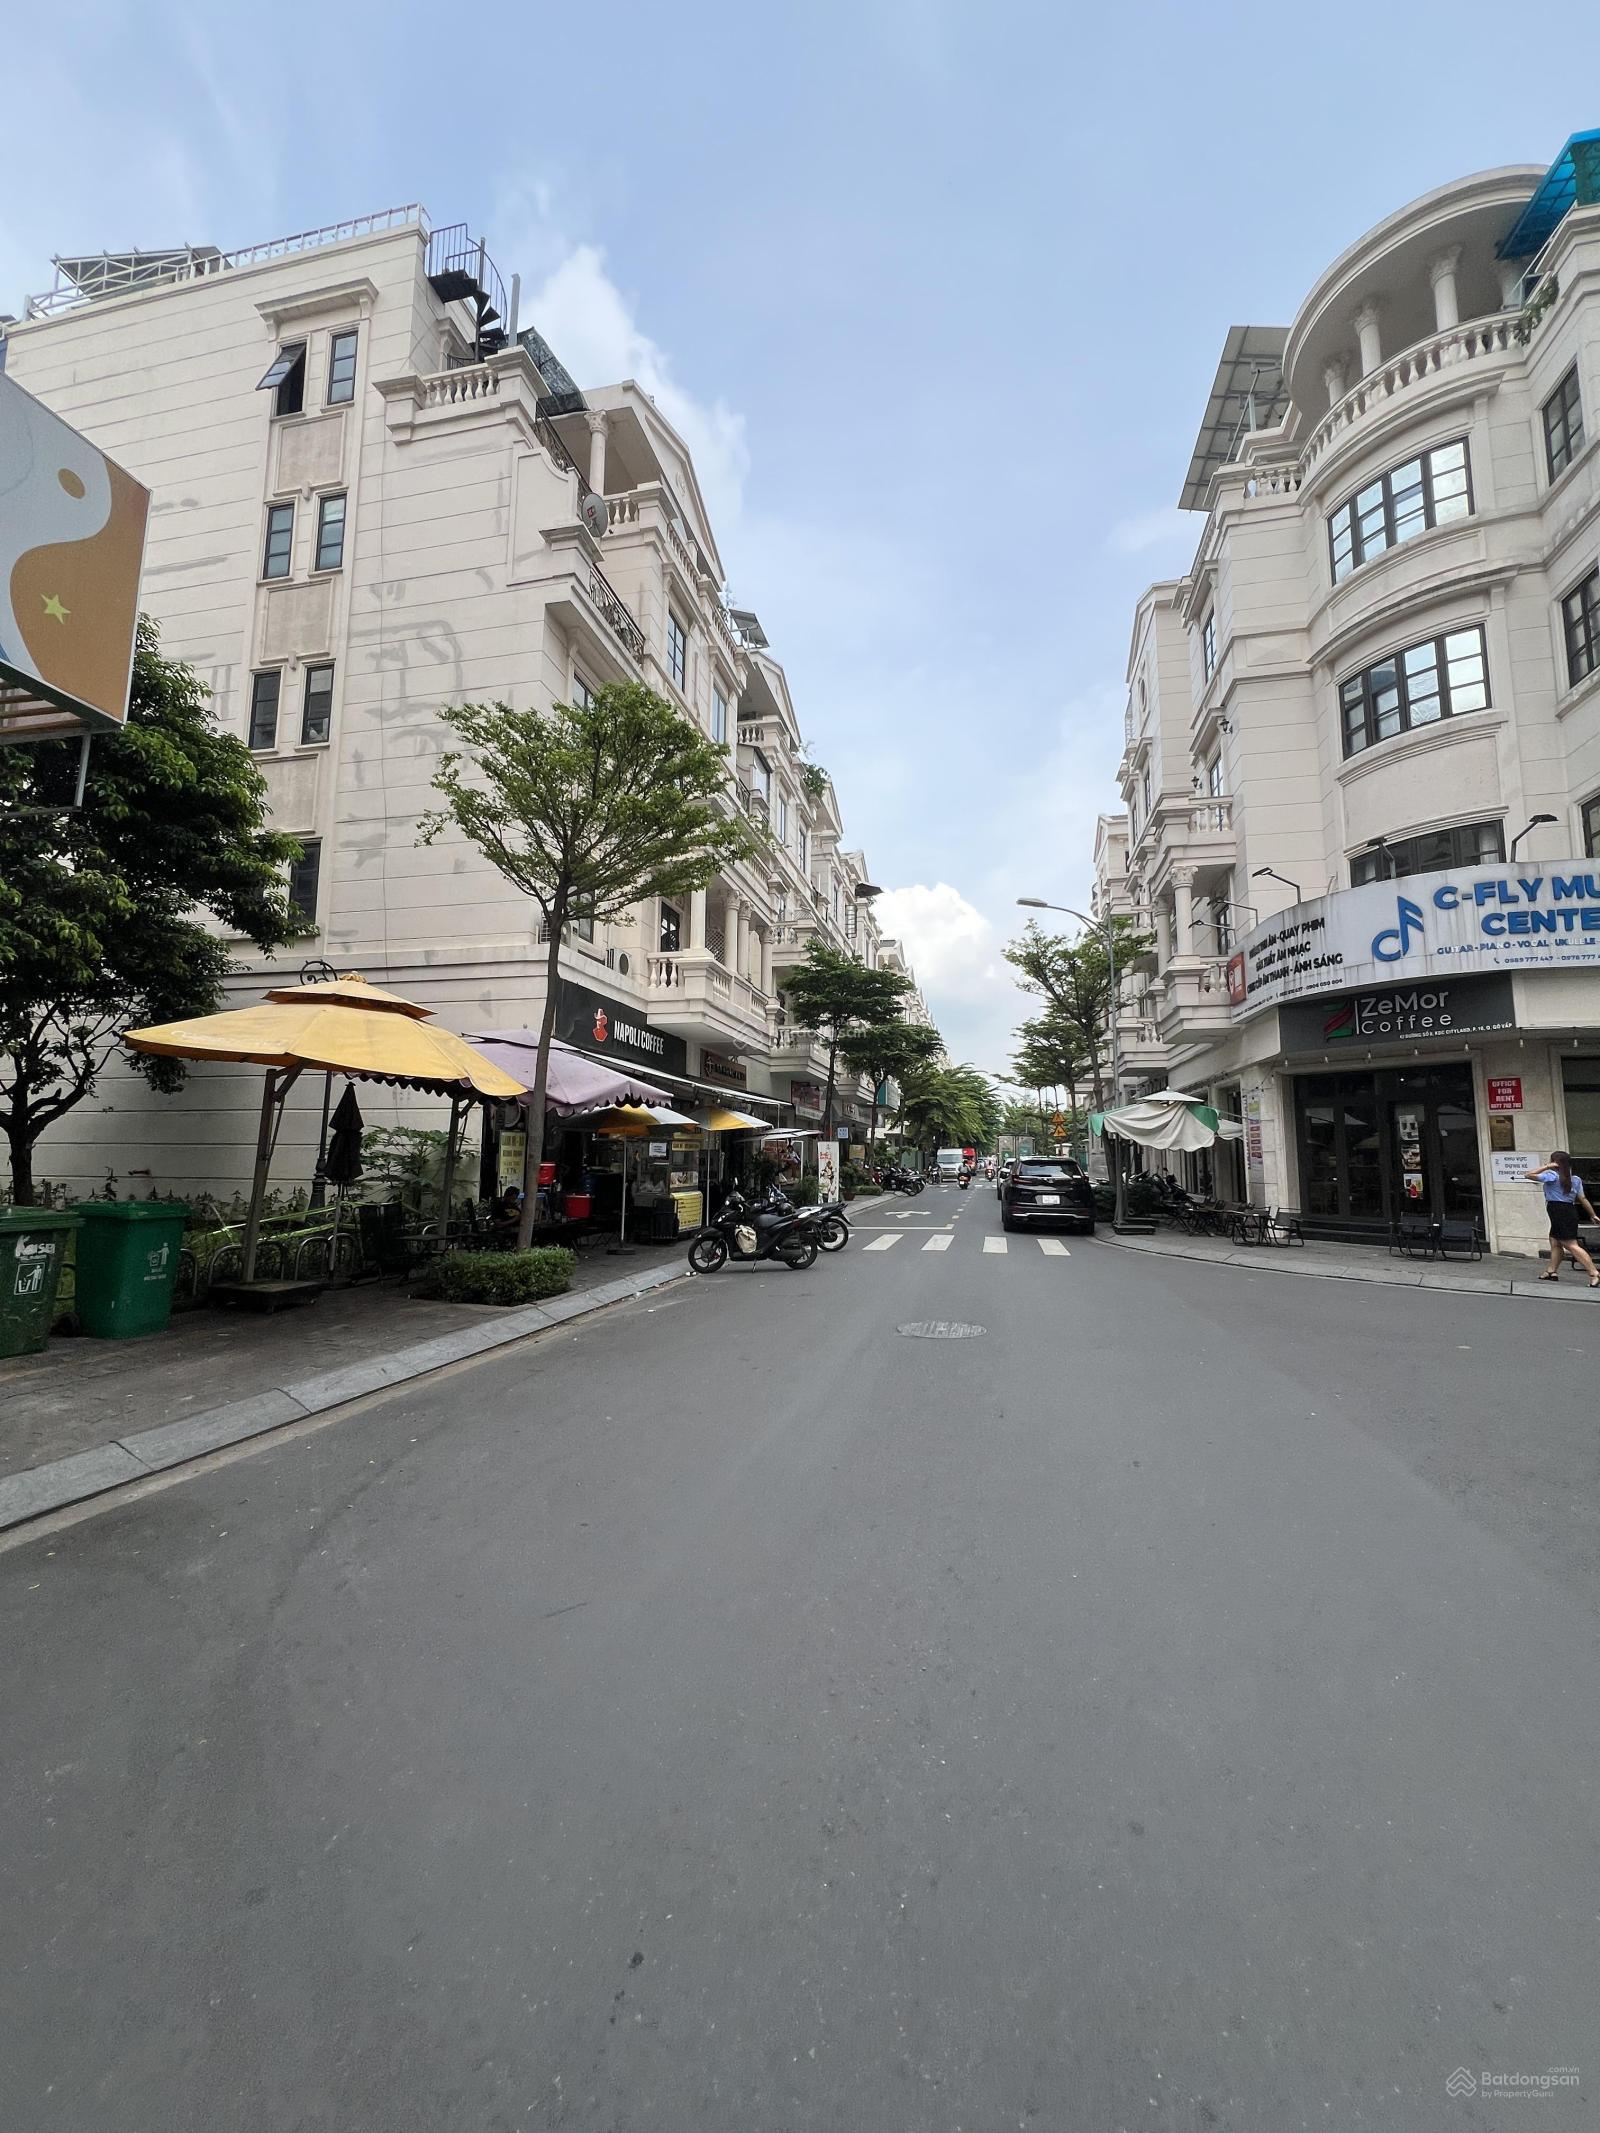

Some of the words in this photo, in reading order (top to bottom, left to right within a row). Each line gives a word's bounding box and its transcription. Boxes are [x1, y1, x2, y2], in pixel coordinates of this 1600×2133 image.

[1433, 877, 1544, 910] C-FLY
[1302, 917, 1325, 934] PHIM
[1287, 941, 1311, 957] NHẠC
[1437, 944, 1473, 955] GUITAR
[1479, 942, 1511, 951] PIANO
[1517, 939, 1549, 949] VOCAL
[1313, 953, 1344, 969] SÁNG
[1361, 991, 1449, 1018] ZeMor
[1361, 1013, 1452, 1035] Coffee
[614, 1020, 640, 1048] NAPOLI
[641, 1030, 664, 1055] COFFEE
